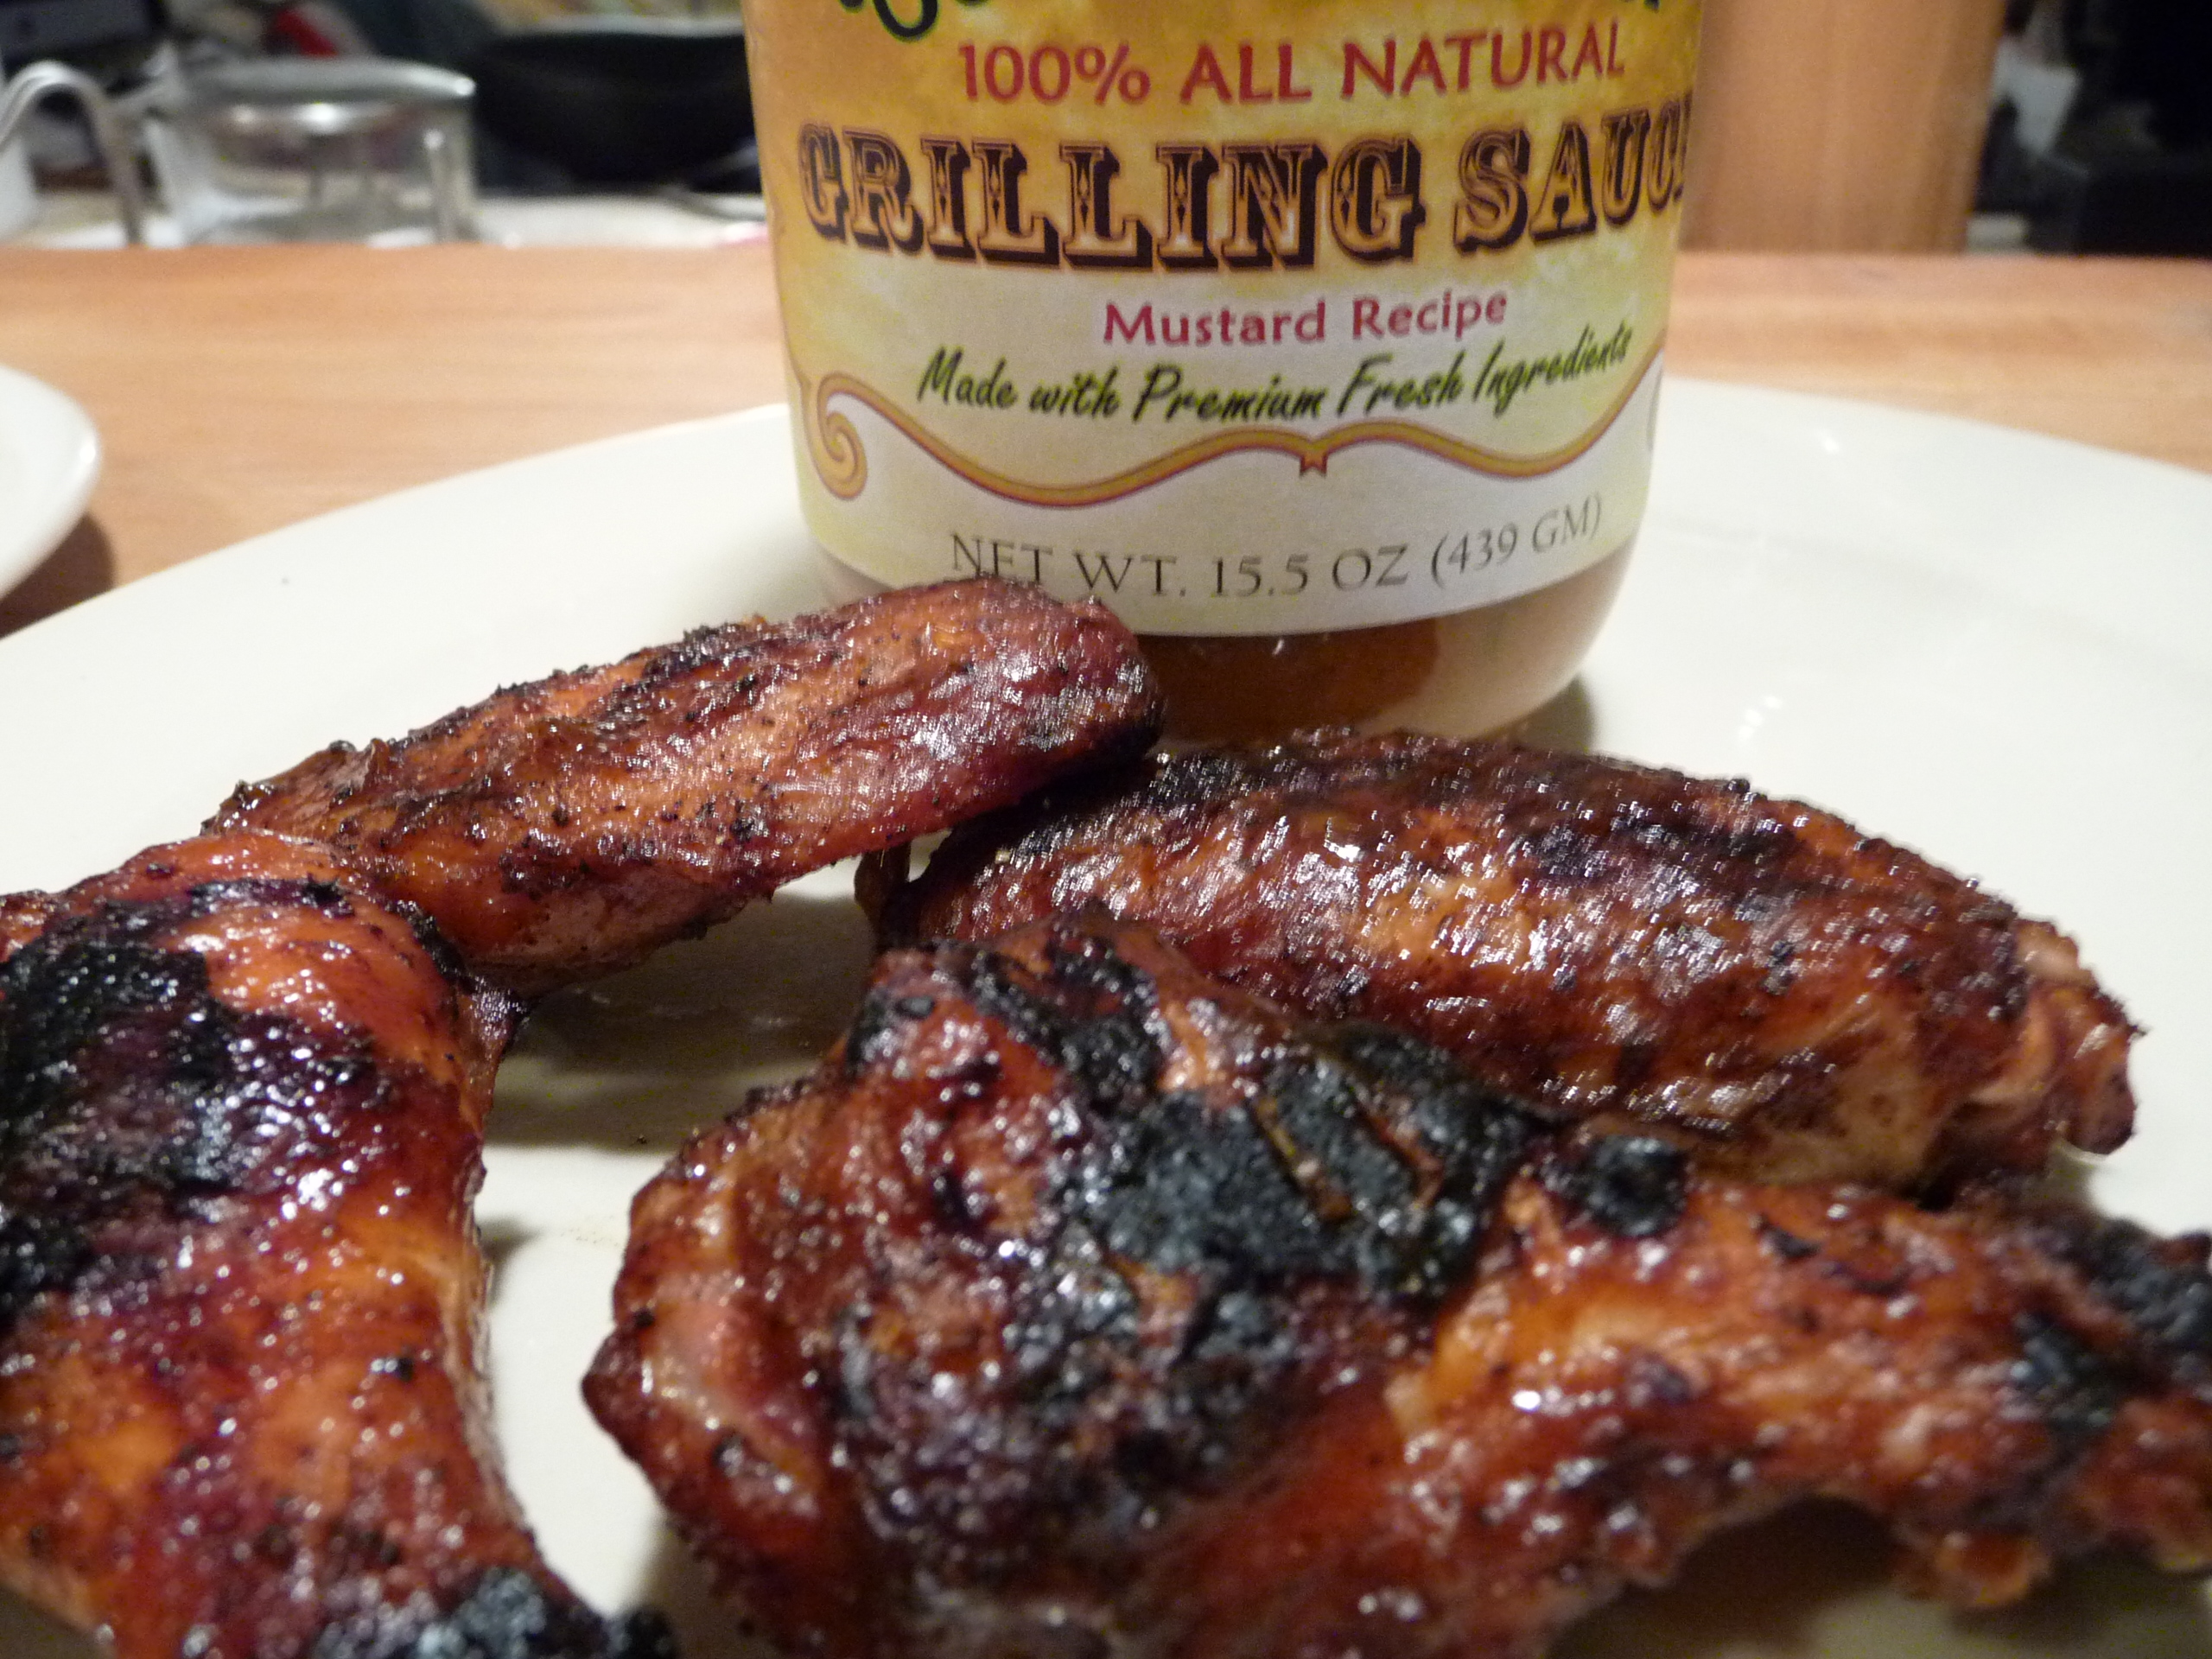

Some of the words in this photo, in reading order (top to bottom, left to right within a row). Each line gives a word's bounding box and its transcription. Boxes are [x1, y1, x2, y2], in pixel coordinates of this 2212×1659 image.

[958, 42, 1152, 105] 100%
[1179, 39, 1312, 104] ALL
[1340, 18, 1625, 100] NATURAL
[798, 121, 1426, 272] GRILLING
[1103, 299, 1325, 346] Mustard
[1352, 289, 1508, 340] Recipe
[917, 346, 1017, 409] Made
[1029, 364, 1122, 419] with
[1132, 363, 1328, 423] Premium
[1337, 349, 1466, 417] Fresh
[1472, 319, 1633, 418] Ingredients
[1072, 552, 1186, 598] WT.
[1210, 553, 1309, 598] 15.5
[1332, 543, 1409, 592] OZ
[1430, 522, 1518, 589] (439
[1531, 492, 1603, 555] GM)
